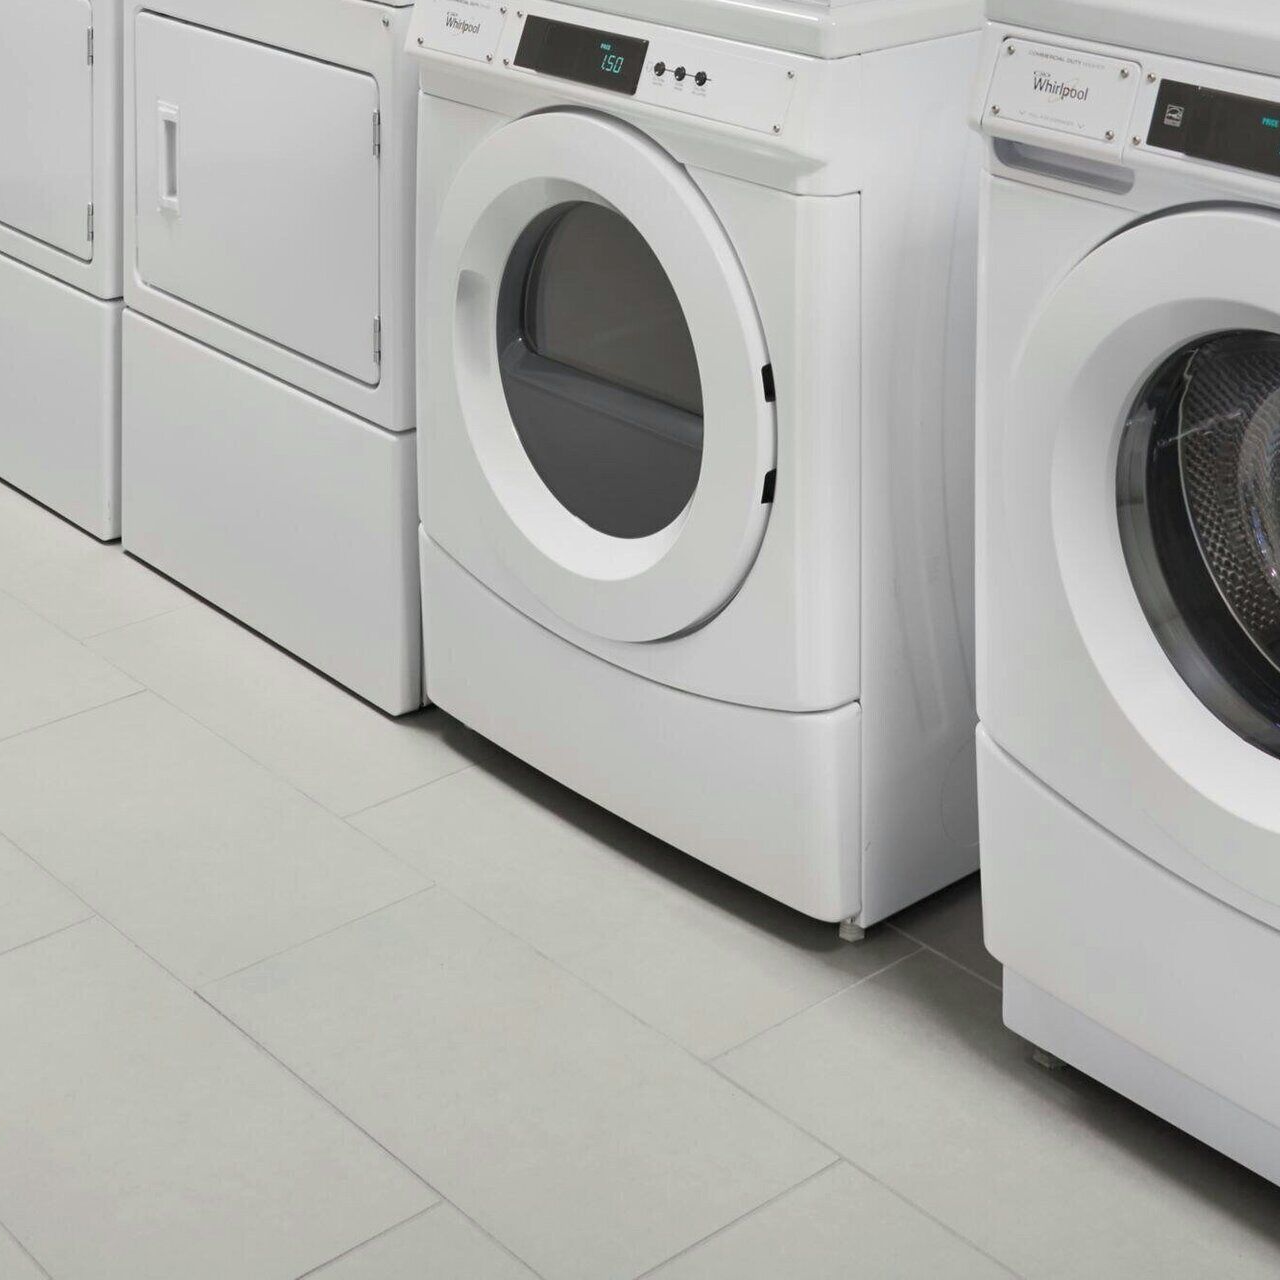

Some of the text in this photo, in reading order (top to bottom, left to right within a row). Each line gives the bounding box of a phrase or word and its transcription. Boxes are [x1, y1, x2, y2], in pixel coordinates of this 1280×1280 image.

[446, 15, 481, 34] Whirlpool
[1033, 77, 1089, 101] Whirlpool
[1261, 117, 1280, 129] PRICE
